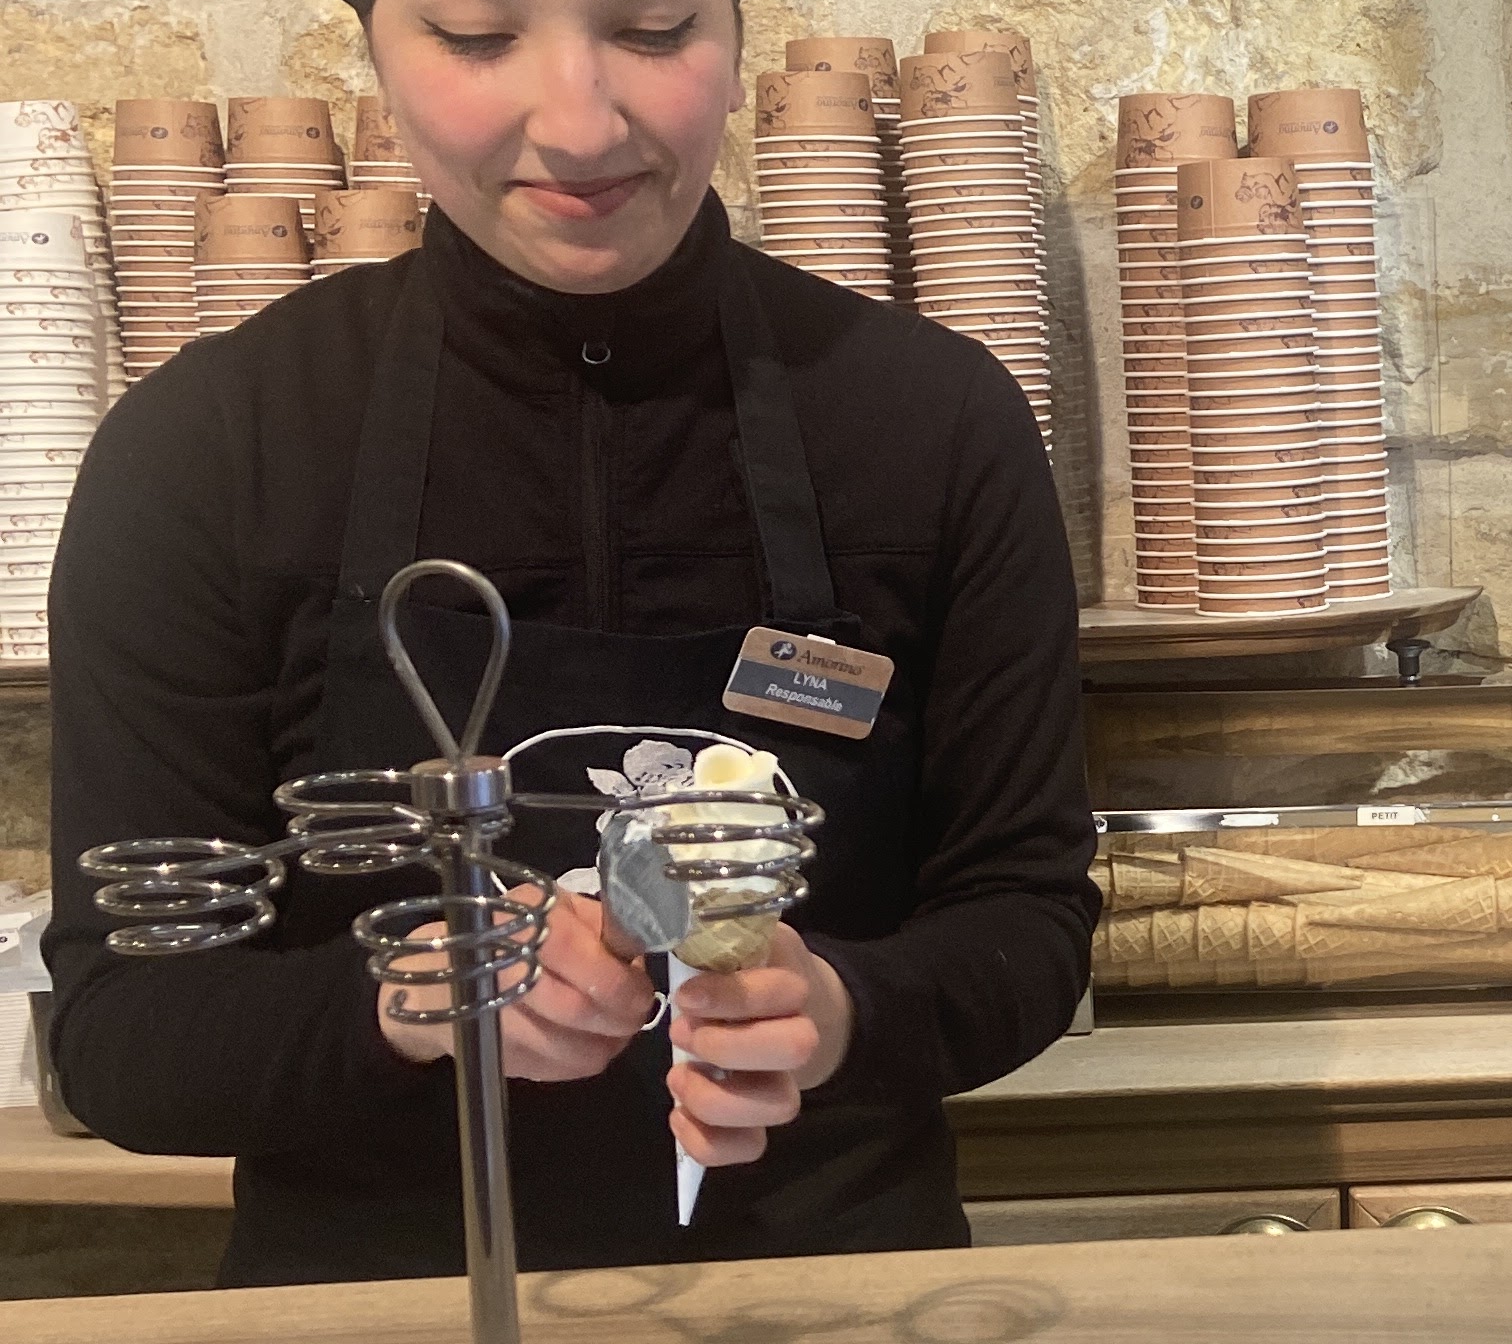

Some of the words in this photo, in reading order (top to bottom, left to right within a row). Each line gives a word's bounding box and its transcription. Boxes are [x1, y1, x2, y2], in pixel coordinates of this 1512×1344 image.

[797, 649, 863, 676] Amorino
[793, 672, 828, 691] LYNA
[765, 683, 844, 713] Responsable
[1371, 811, 1399, 820] PETIT
